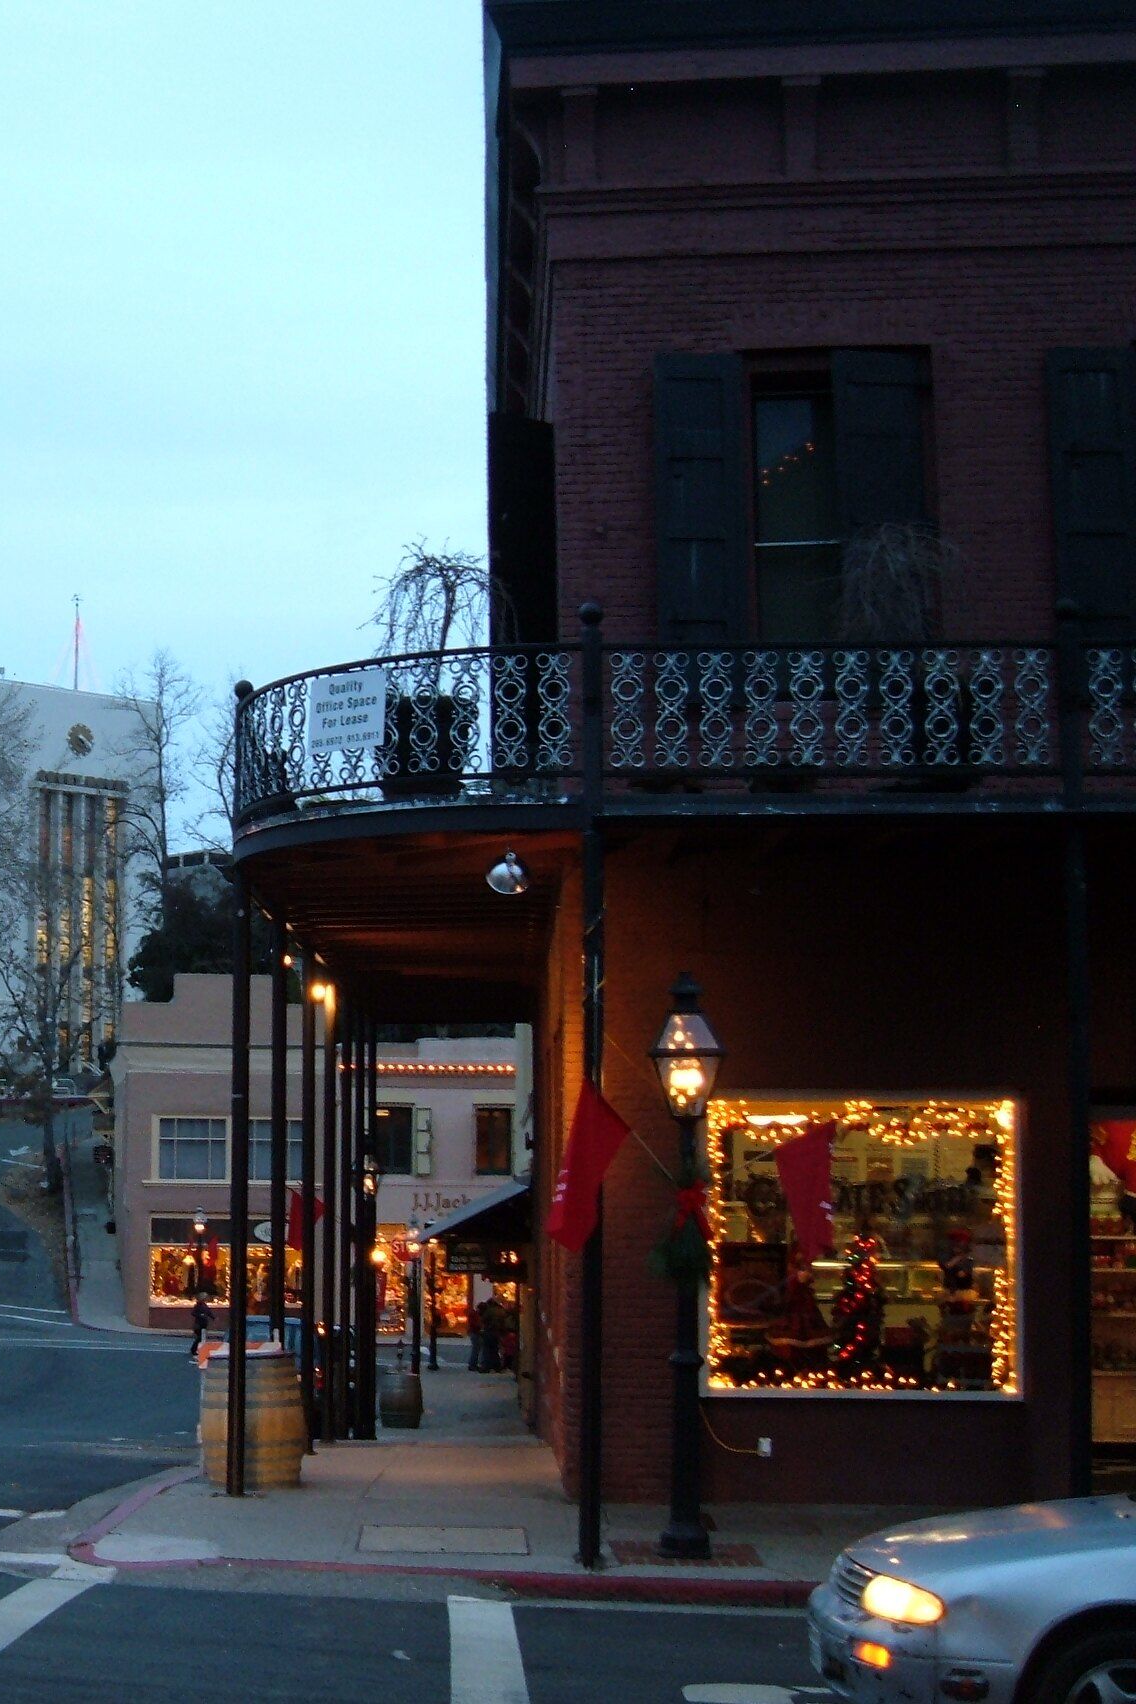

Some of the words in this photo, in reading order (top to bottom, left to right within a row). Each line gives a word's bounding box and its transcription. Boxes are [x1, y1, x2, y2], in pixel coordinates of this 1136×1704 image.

[328, 680, 363, 696] Quality
[315, 700, 344, 714] Office
[347, 695, 378, 710] Space
[321, 716, 337, 730] For
[340, 714, 369, 726] Lease
